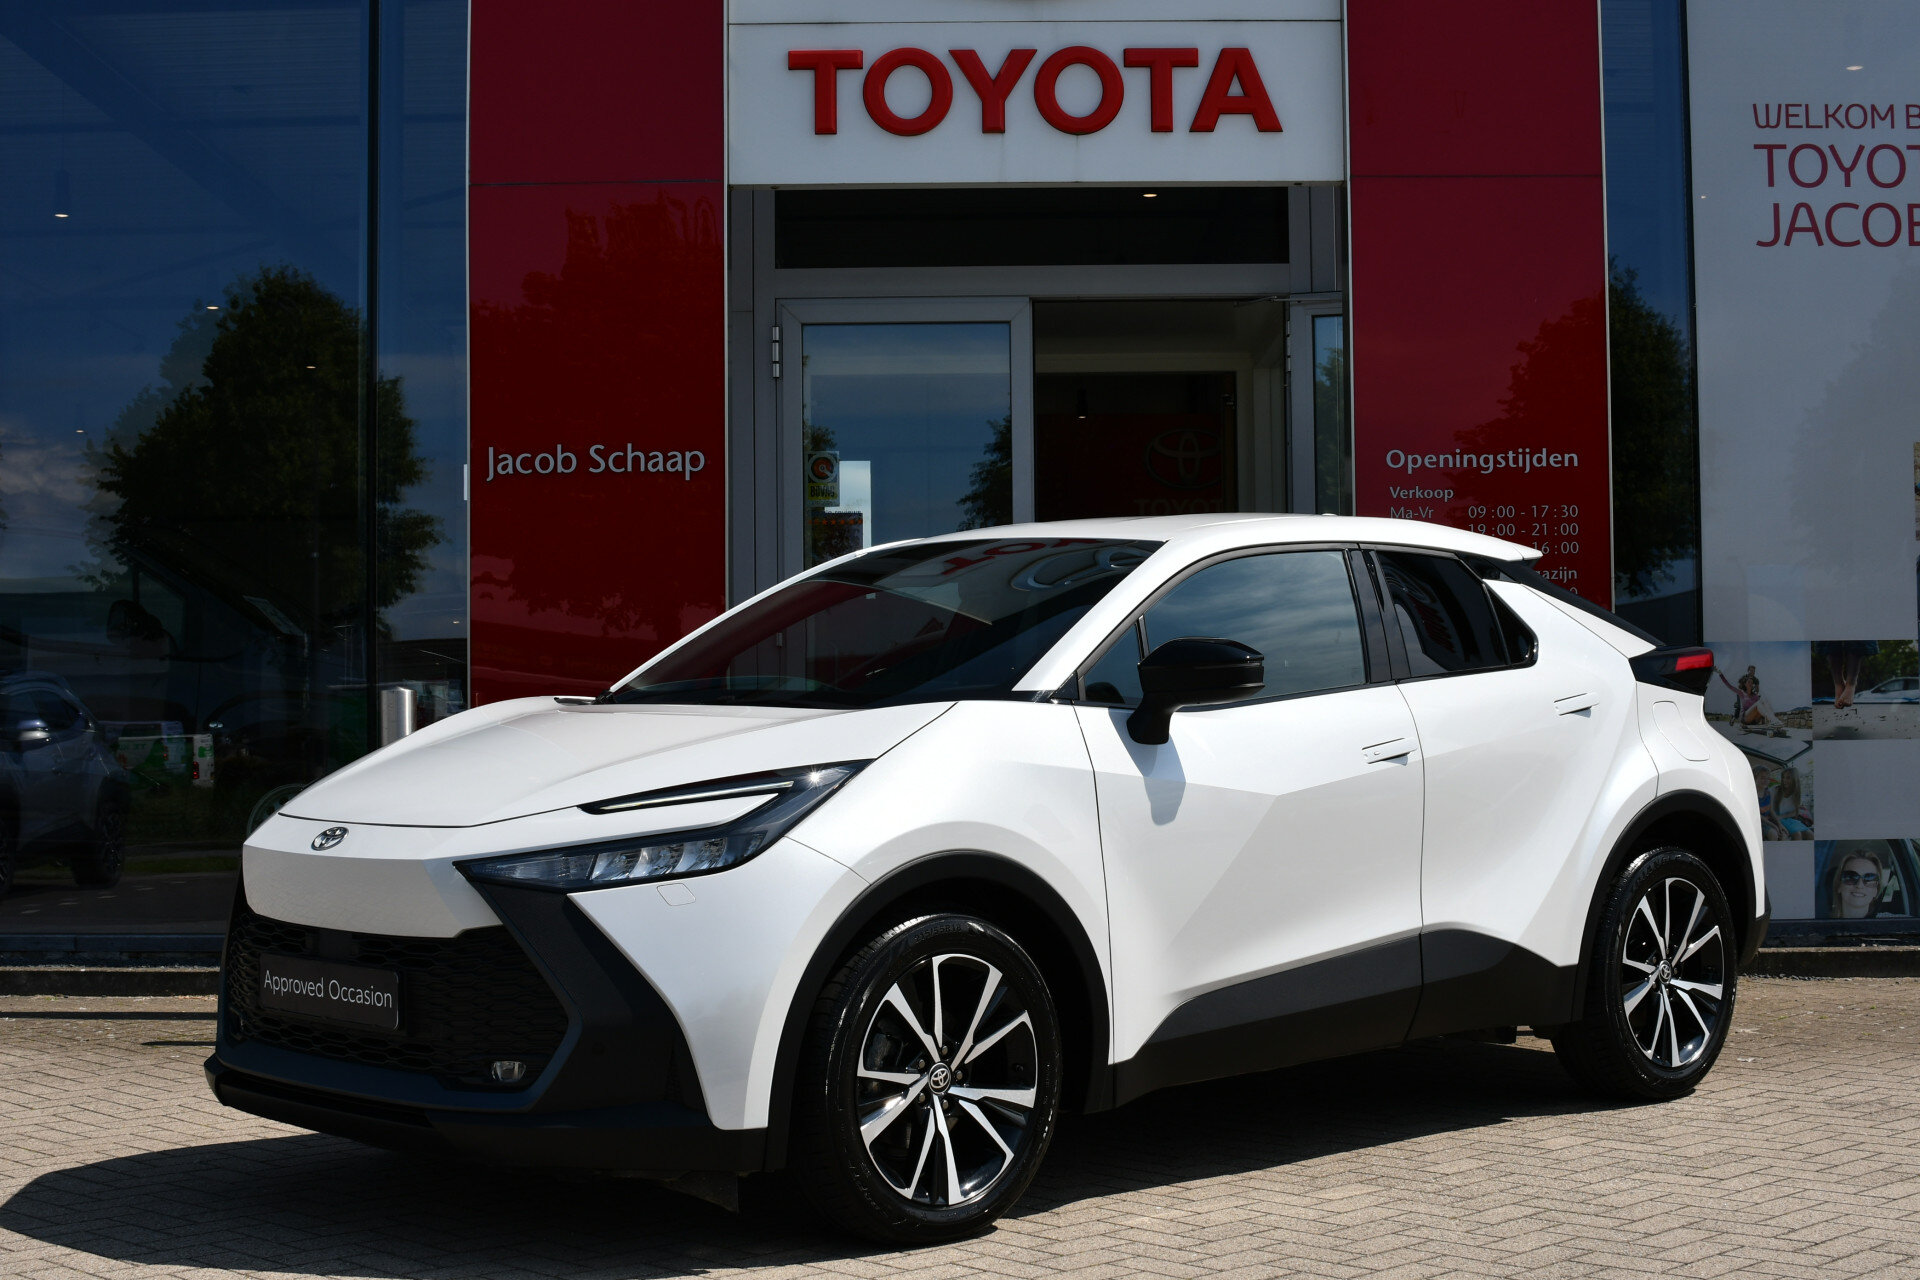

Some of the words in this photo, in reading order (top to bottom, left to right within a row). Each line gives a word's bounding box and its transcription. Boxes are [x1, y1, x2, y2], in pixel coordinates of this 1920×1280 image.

[788, 46, 1284, 137] TOYOTA
[1752, 103, 1895, 130] WELKOM
[486, 443, 578, 482] Jacob
[588, 442, 706, 481] Schaap
[1386, 448, 1579, 475] Openingstijden
[1389, 486, 1455, 502] Verkoop
[1390, 506, 1434, 519] Ma-Vr
[1536, 566, 1578, 583] azijn
[264, 969, 324, 998] Approved
[328, 979, 393, 1008] Occasion
